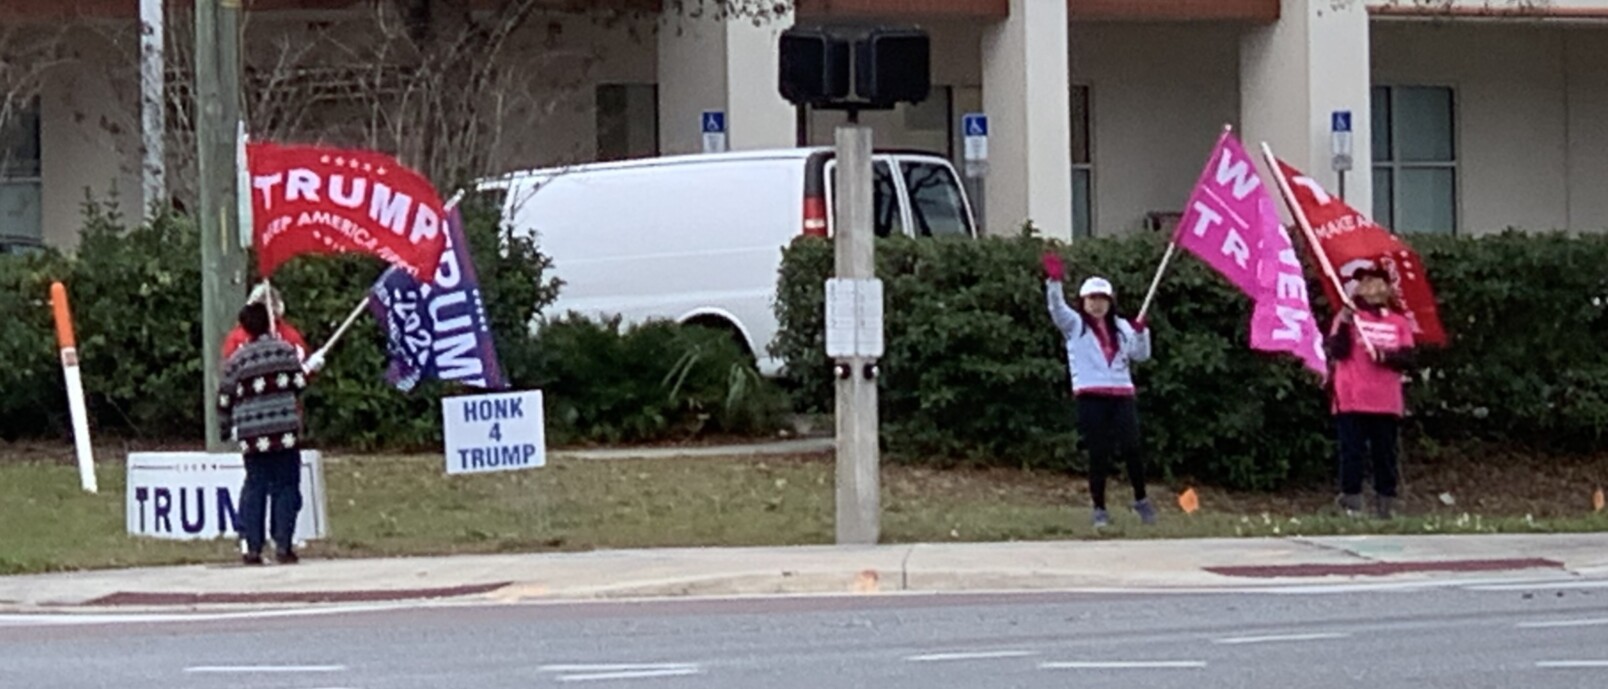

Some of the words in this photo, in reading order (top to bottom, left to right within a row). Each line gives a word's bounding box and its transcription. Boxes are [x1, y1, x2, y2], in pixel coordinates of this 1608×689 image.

[254, 167, 439, 245] TRUMP
[297, 210, 378, 251] AMERICA
[463, 396, 523, 422] HONK
[489, 422, 502, 441] 4
[458, 444, 536, 469] TRUMP
